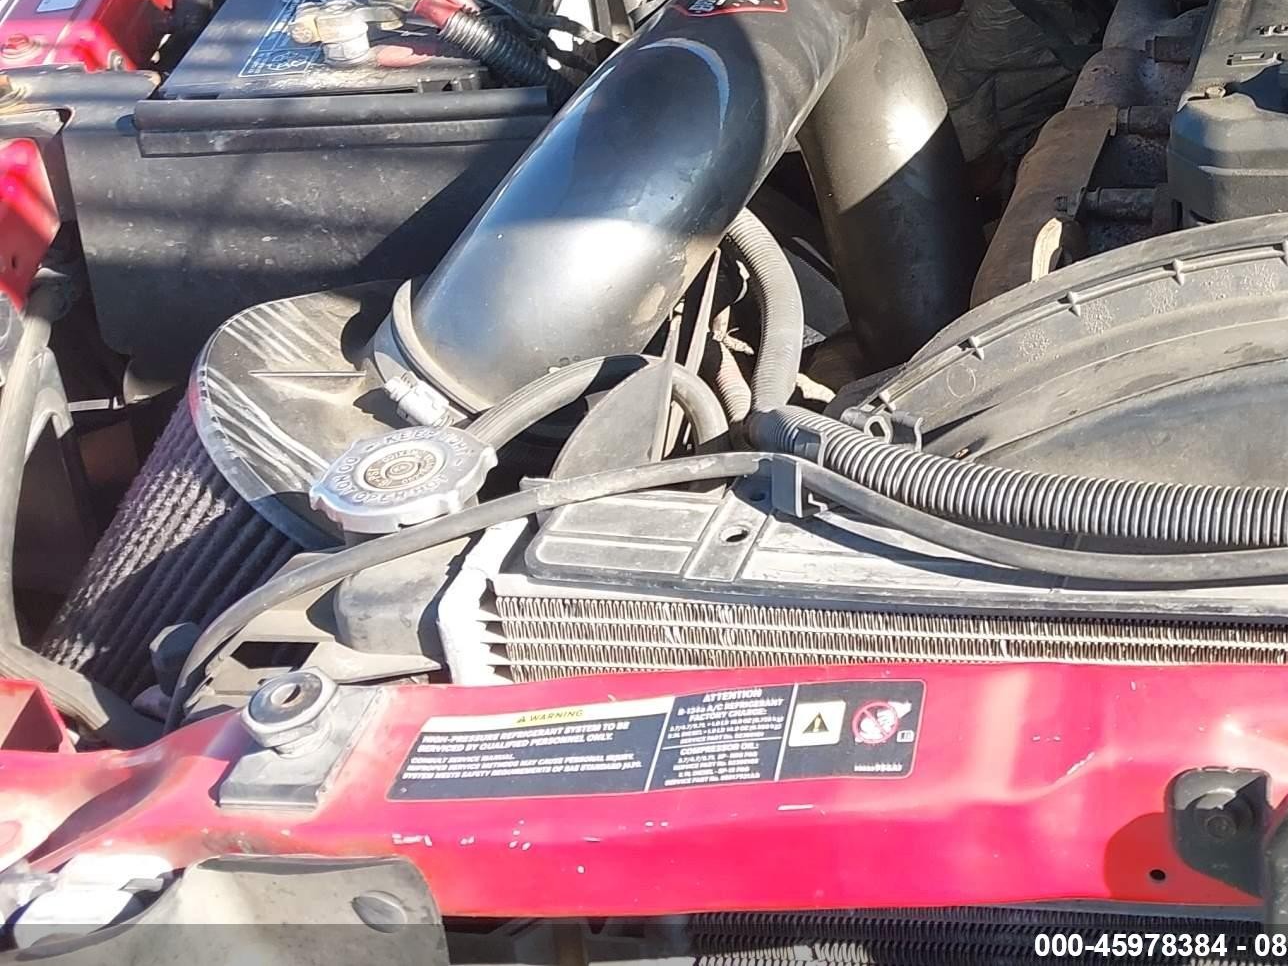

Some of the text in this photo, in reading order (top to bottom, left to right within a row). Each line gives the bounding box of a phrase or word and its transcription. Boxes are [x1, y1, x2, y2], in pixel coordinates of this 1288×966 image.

[702, 689, 763, 703] ATTENTION
[706, 703, 724, 713] A/C
[724, 698, 785, 710] REFRIGERANT
[530, 709, 583, 722] WARNING
[688, 710, 728, 722] FACTORY
[421, 721, 631, 744] HIGH-PRESSURE REFRIGERANT SYSTEM TO BE
[417, 733, 614, 753] SERVICED BY QUALIFIED PERSONNEL ONLY.
[680, 743, 740, 756] COMPRESSOR
[552, 765, 565, 773] OF
